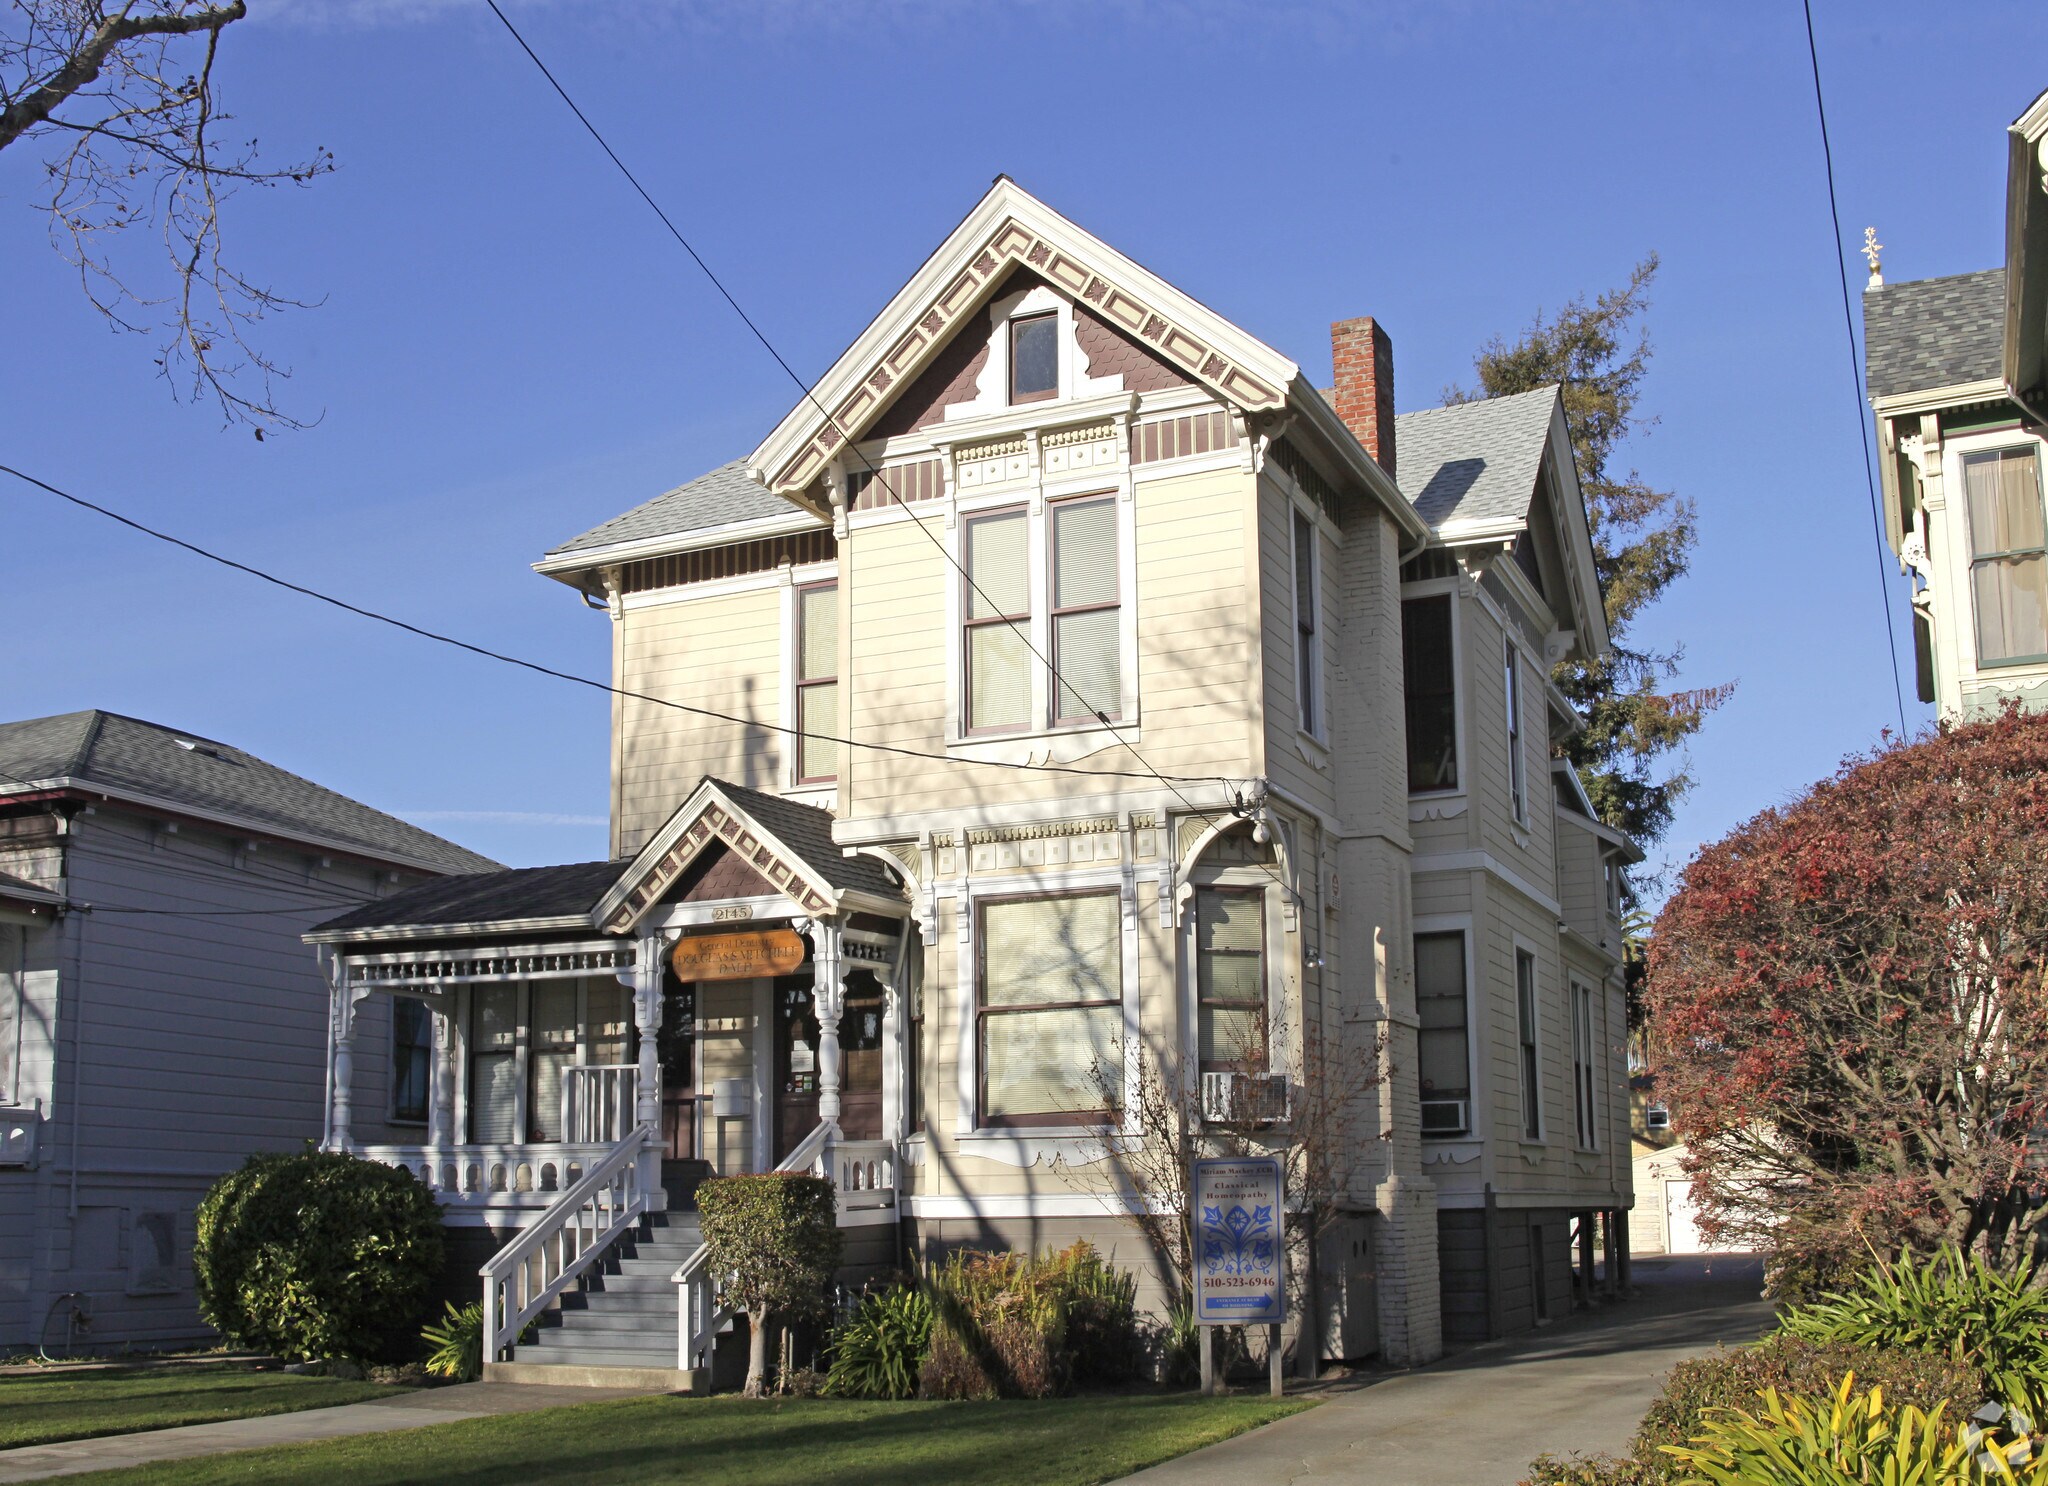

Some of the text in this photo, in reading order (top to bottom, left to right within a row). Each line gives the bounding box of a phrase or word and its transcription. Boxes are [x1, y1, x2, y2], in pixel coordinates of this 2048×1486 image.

[716, 907, 747, 920] 2145
[699, 939, 732, 951] General
[1214, 1180, 1259, 1189] Classical
[1207, 1191, 1267, 1200] Homeopathy
[1205, 1277, 1275, 1287] 510-523-6946
